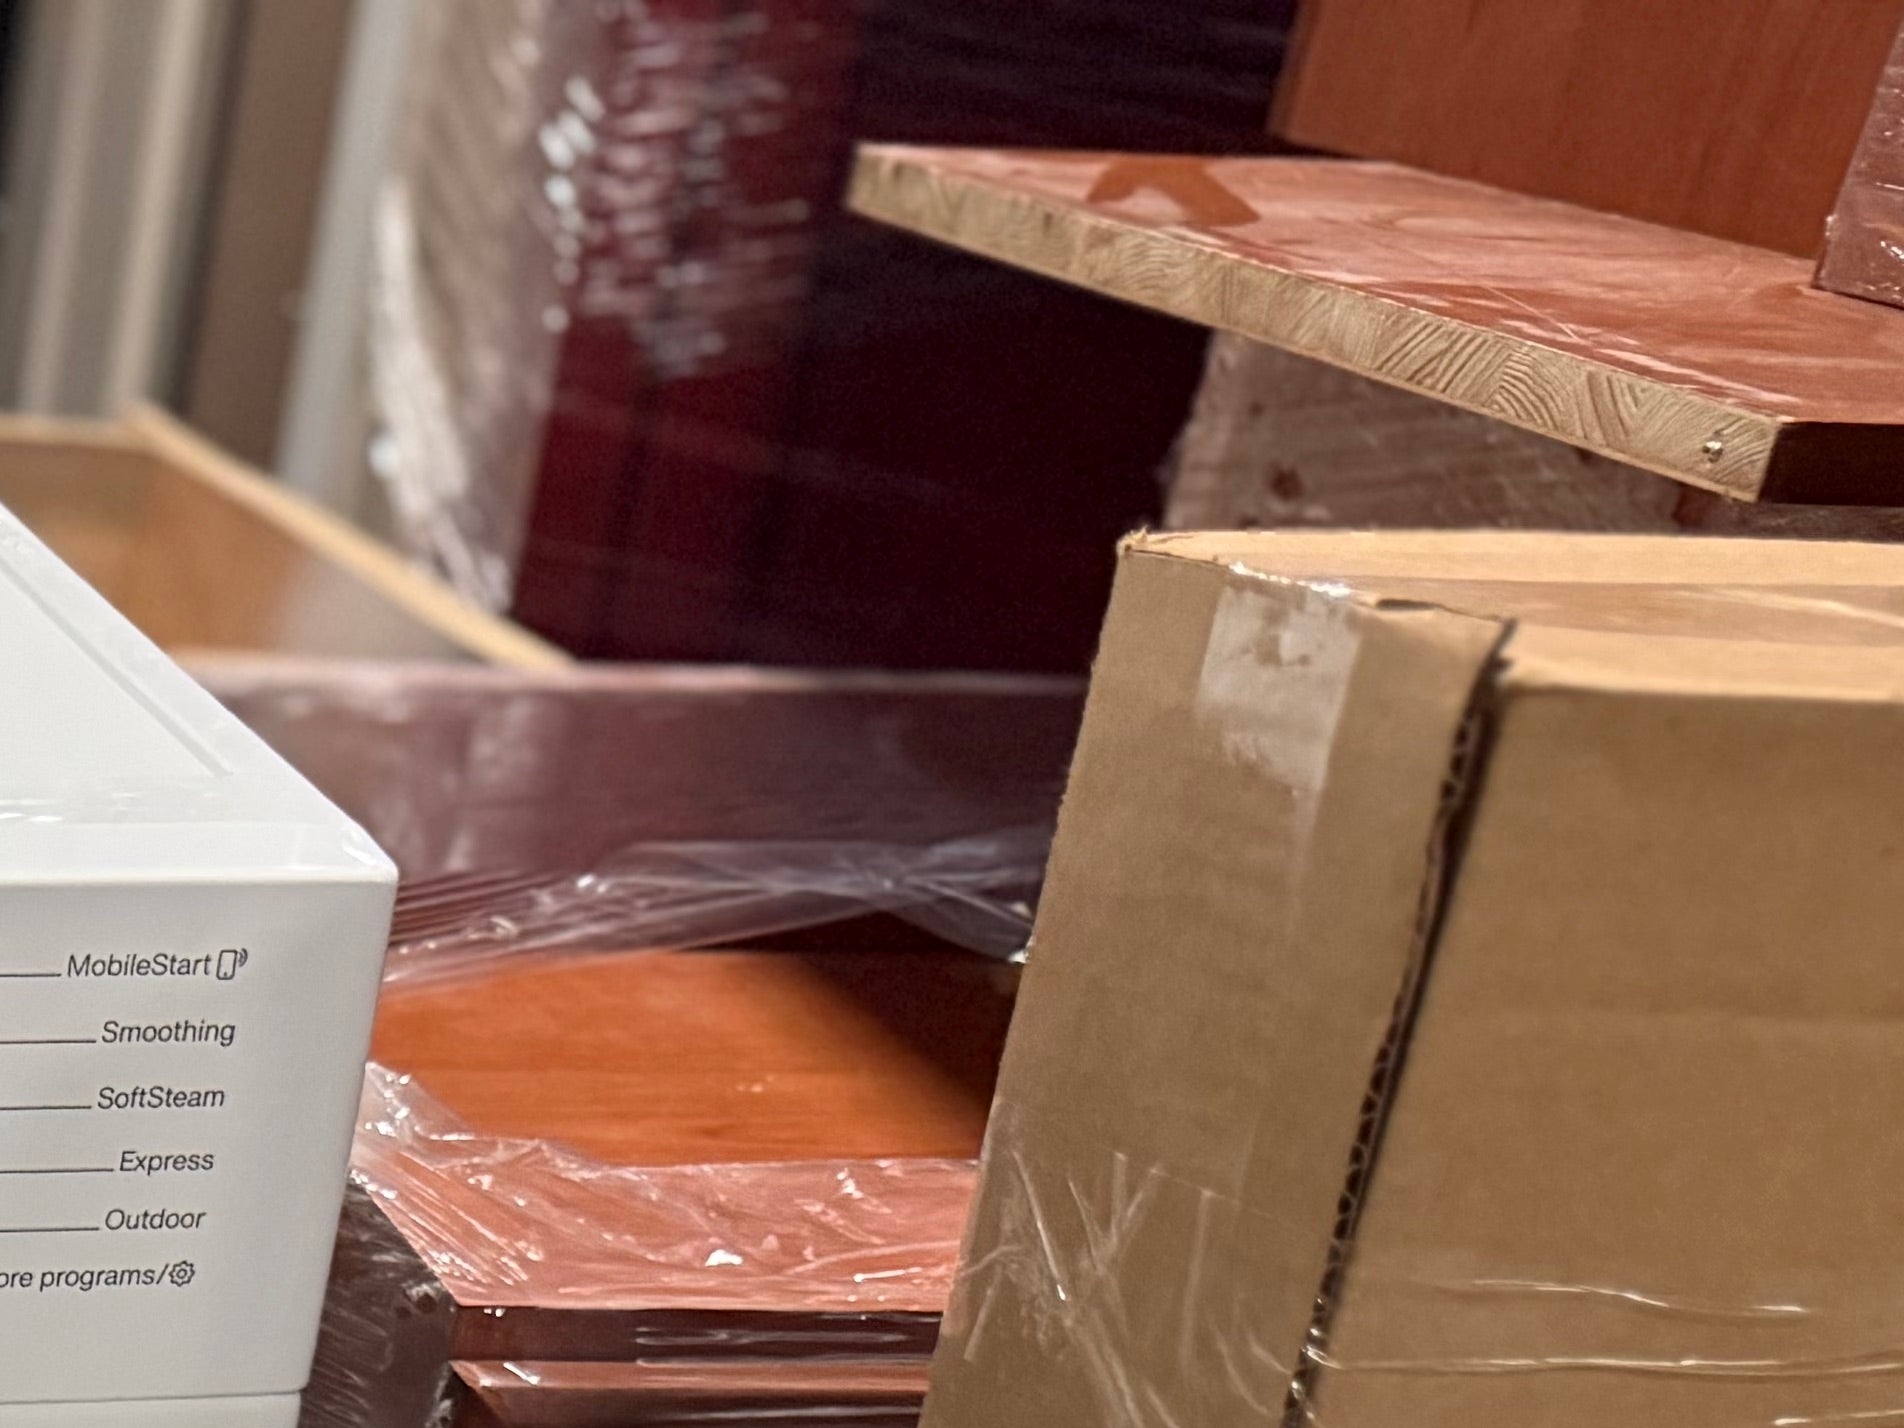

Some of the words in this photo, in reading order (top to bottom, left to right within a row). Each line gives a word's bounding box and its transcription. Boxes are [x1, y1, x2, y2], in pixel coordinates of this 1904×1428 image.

[67, 952, 212, 978] MobileStart
[101, 1019, 236, 1048] Smoothing
[97, 1085, 225, 1110] SoftSteam
[119, 1150, 215, 1177] Express
[104, 1208, 207, 1231] Outdoor
